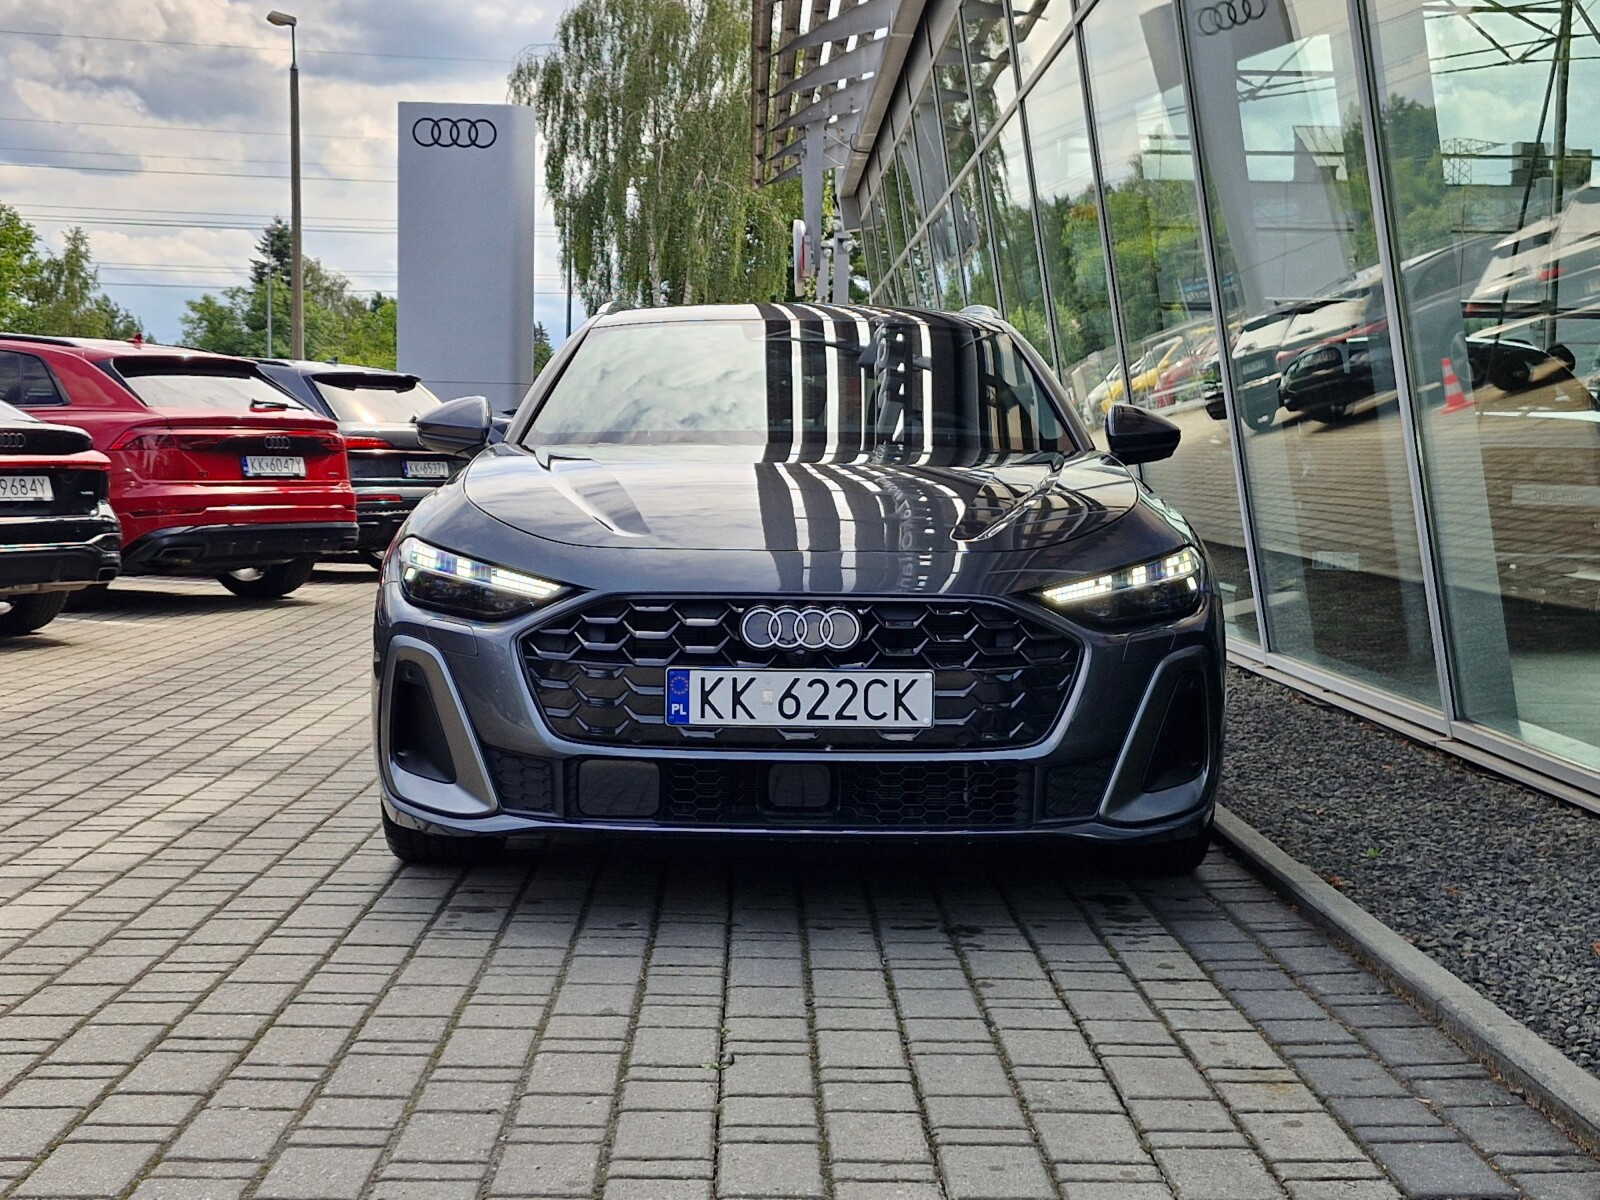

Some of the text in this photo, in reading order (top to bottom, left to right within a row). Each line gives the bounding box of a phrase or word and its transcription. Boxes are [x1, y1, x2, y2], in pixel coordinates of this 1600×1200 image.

[250, 457, 265, 472] KK
[270, 457, 301, 472] 6047Y
[700, 676, 919, 721] KK 622CK
[671, 703, 688, 716] PL
